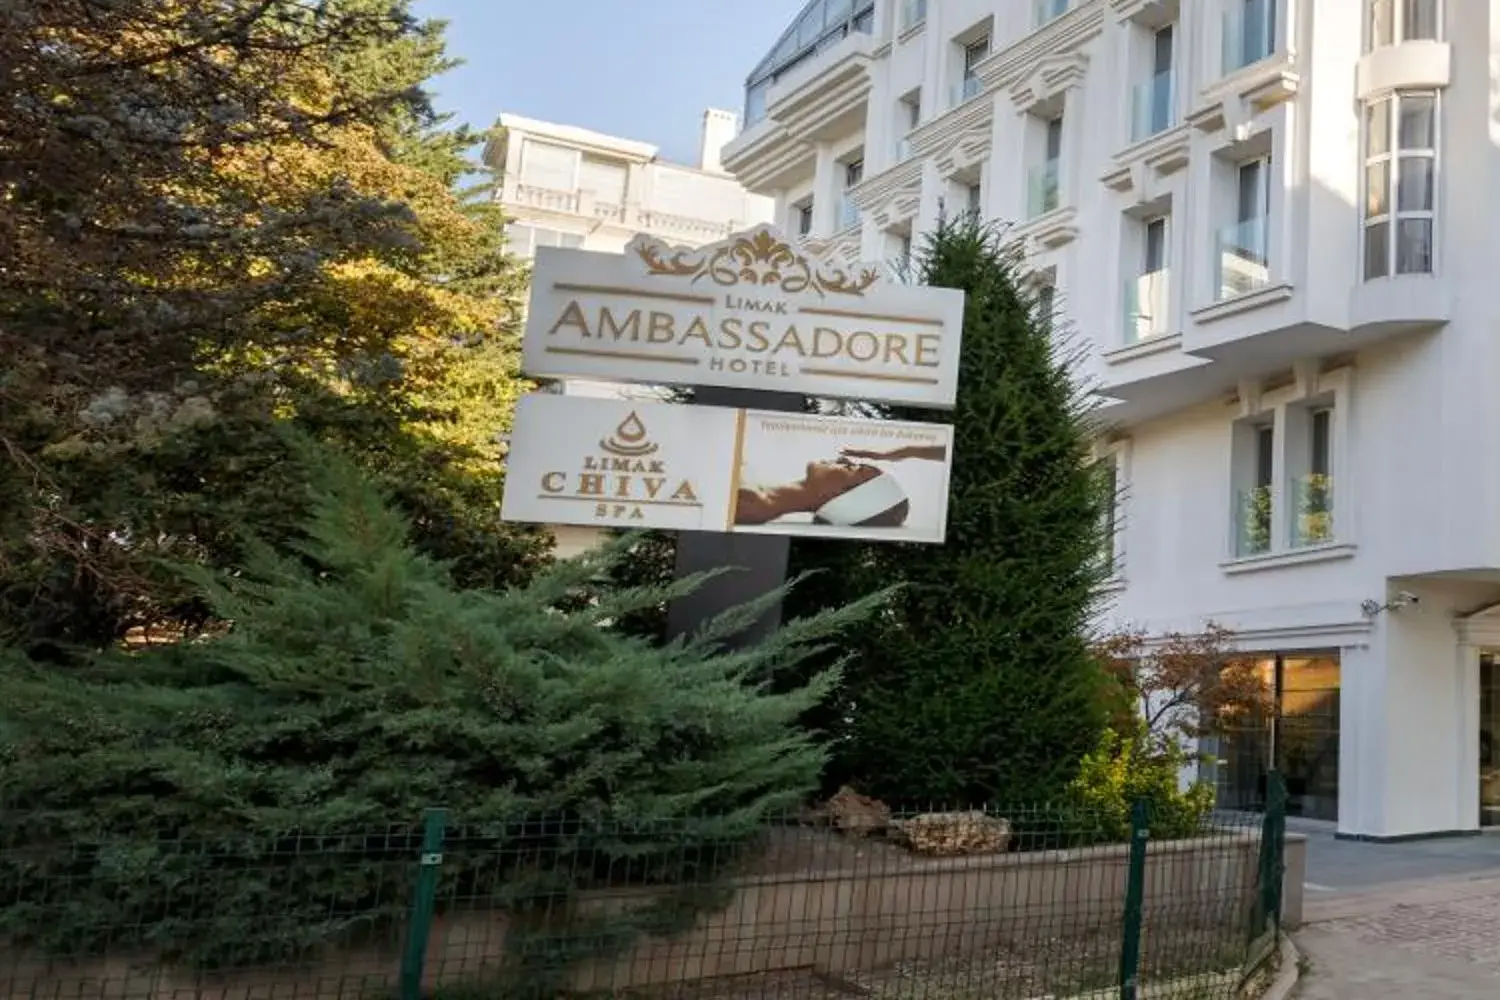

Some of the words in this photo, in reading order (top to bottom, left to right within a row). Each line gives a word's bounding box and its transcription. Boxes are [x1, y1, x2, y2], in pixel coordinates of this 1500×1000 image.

[725, 294, 788, 315] LIMAK
[547, 299, 942, 367] AMBASSADORE
[709, 355, 790, 377] HOTEL
[584, 456, 665, 474] LIMAK
[541, 471, 698, 501] CHIVA
[595, 503, 644, 519] SPA
